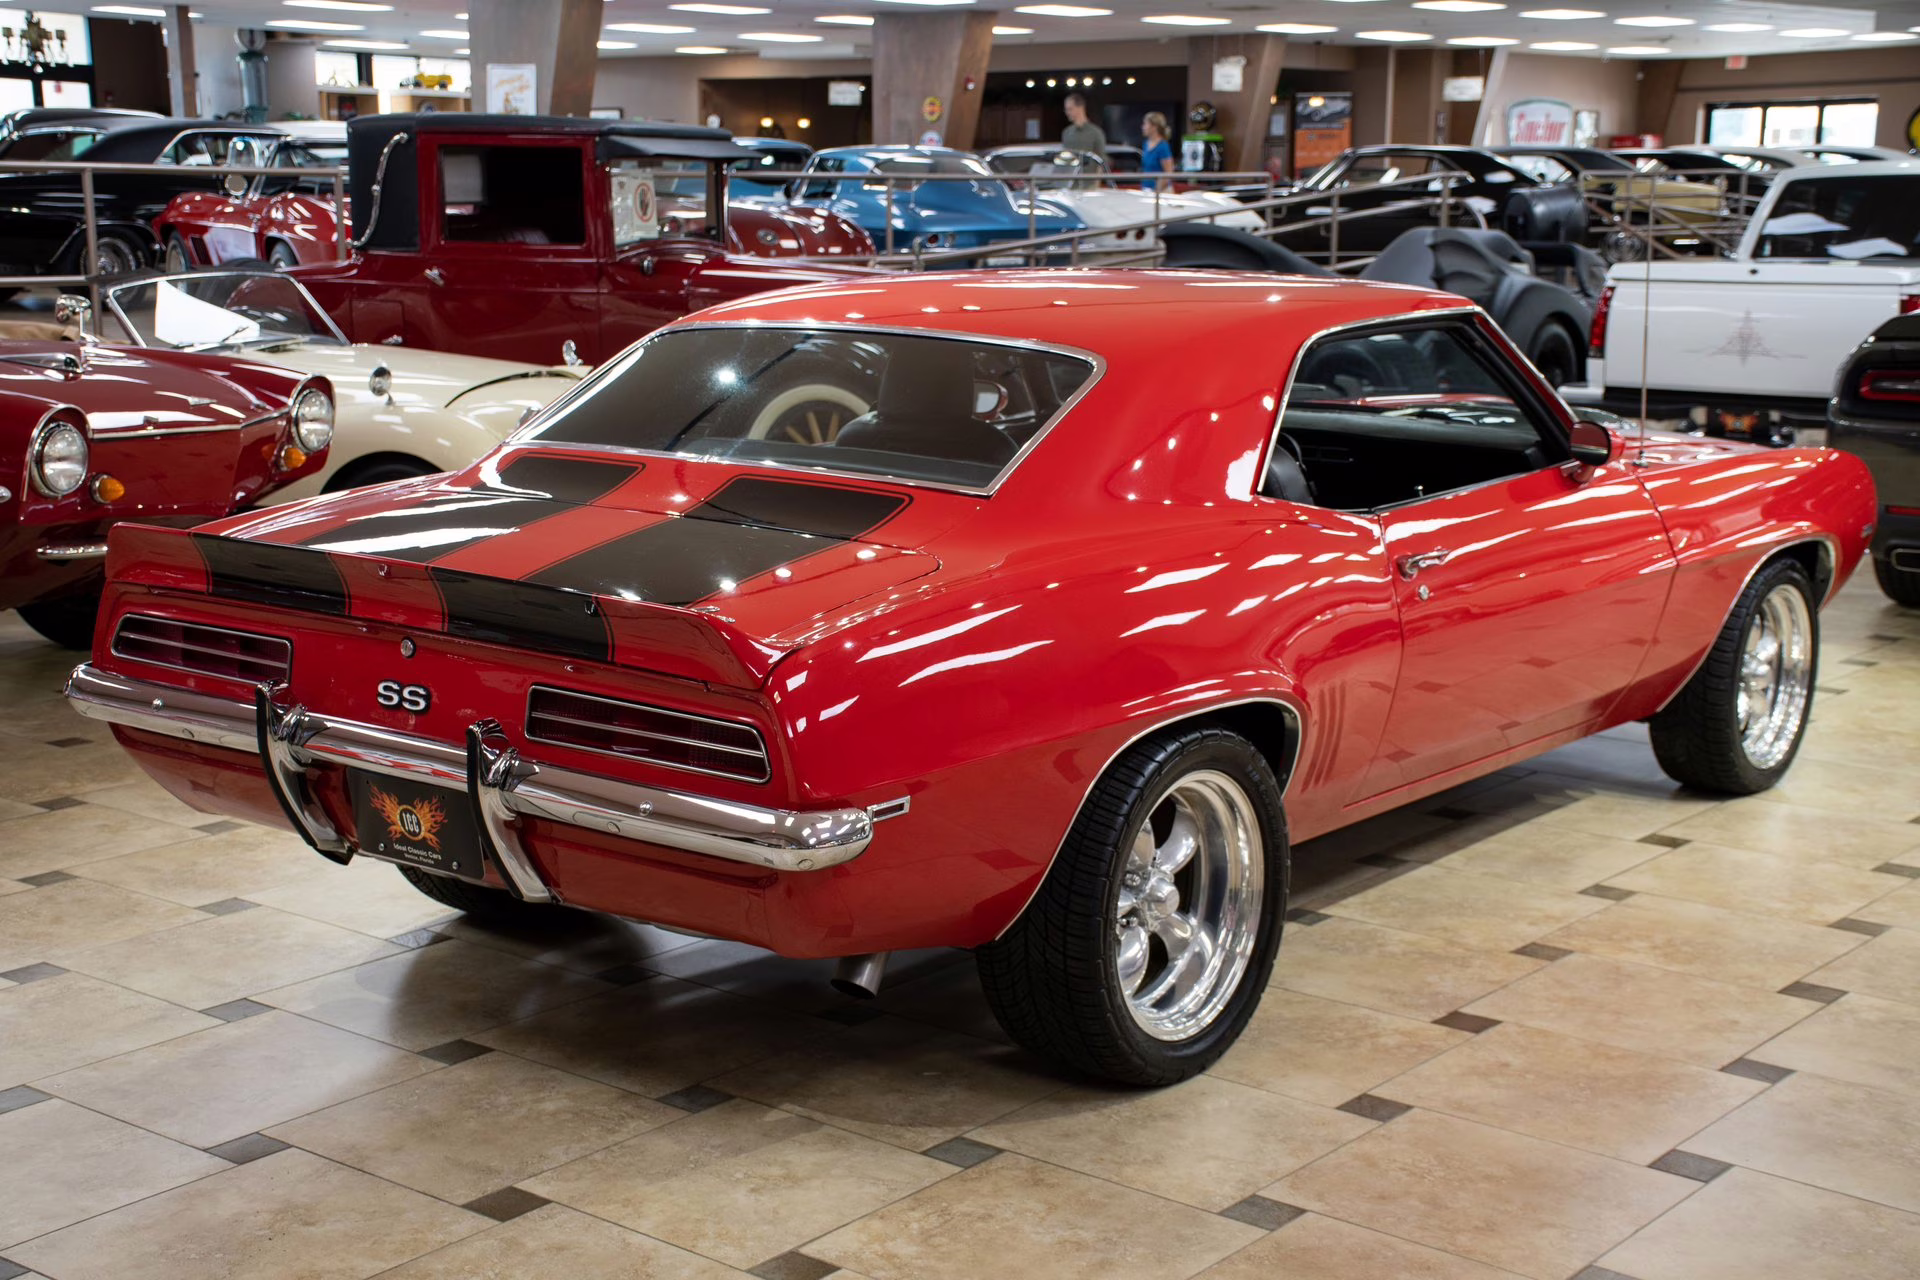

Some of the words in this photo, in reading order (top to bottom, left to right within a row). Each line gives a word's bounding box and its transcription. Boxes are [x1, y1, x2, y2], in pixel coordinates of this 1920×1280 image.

[377, 681, 427, 711] SS
[402, 812, 420, 834] ICC
[407, 846, 428, 857] Classic
[428, 850, 442, 861] Cars
